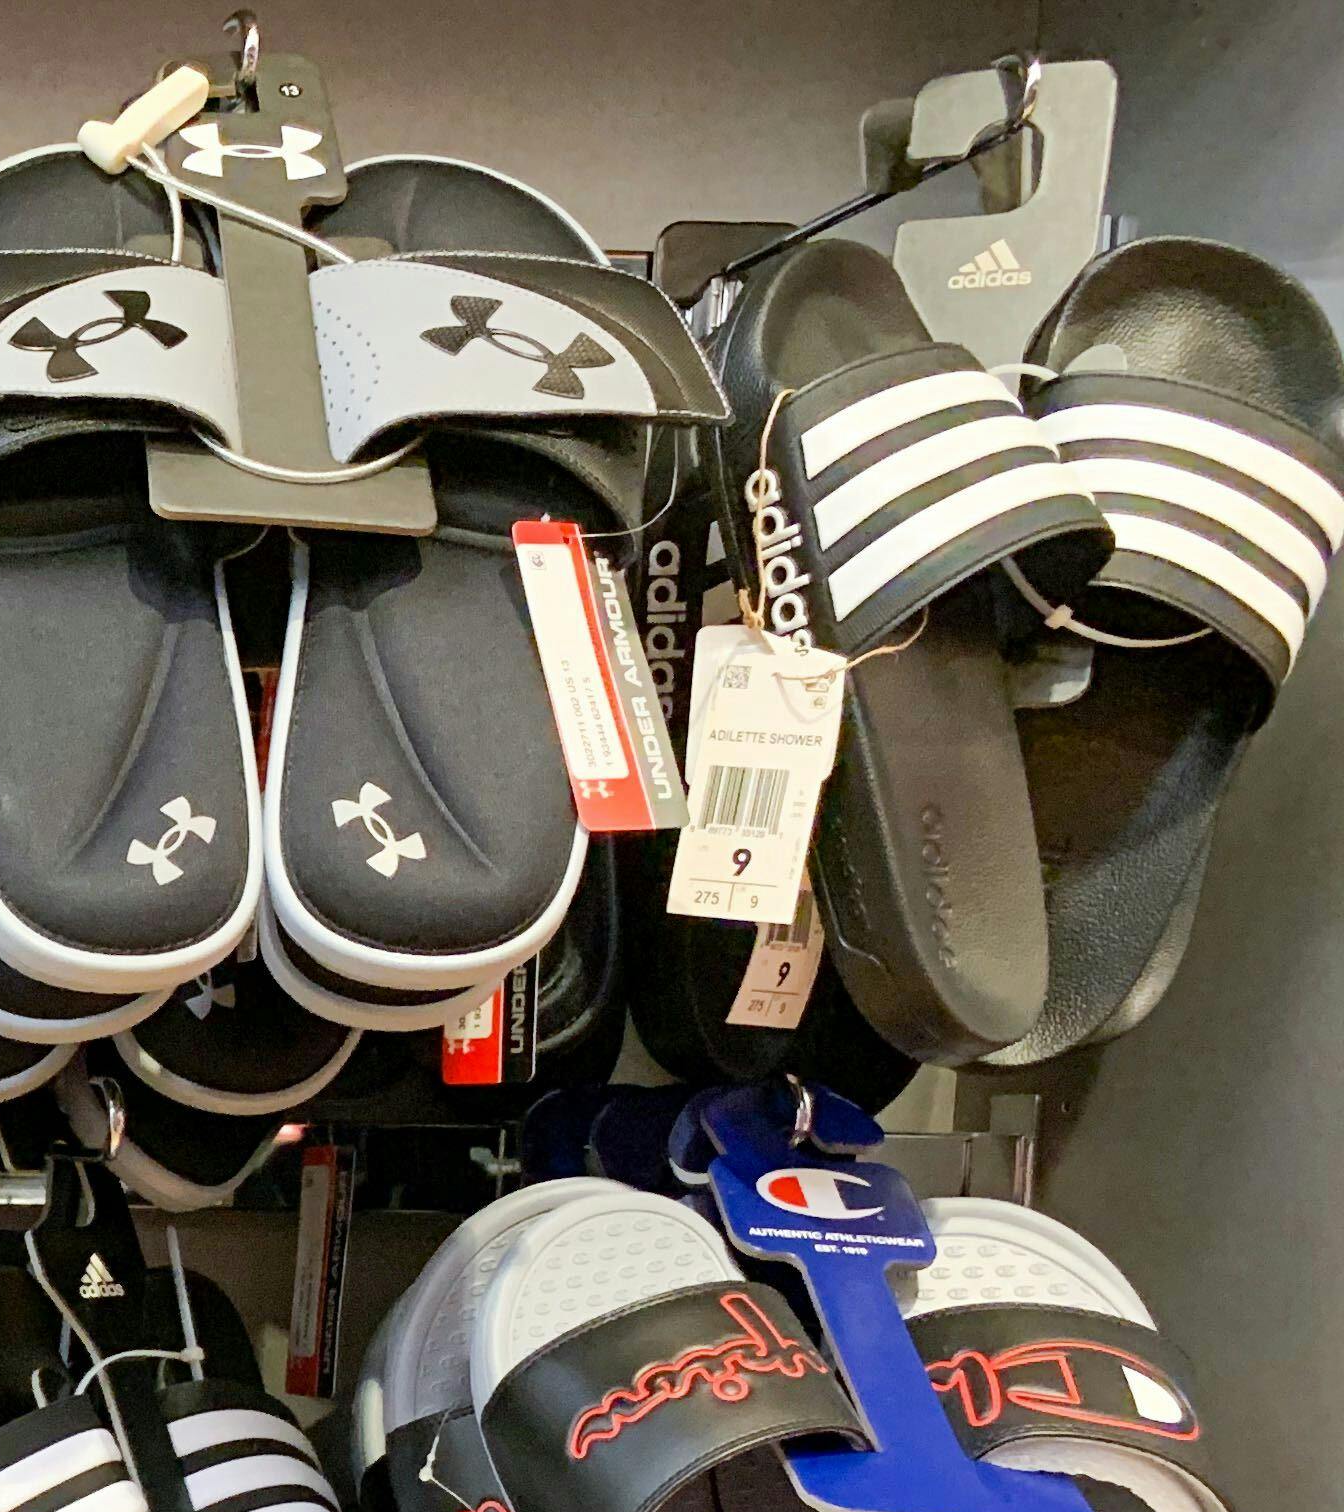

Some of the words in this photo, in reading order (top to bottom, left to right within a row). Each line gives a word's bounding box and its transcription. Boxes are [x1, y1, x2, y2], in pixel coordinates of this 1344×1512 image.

[281, 85, 300, 97] 13
[947, 268, 1032, 290] adidas
[744, 467, 813, 657] adidas
[594, 553, 644, 689] ARMOUR
[630, 696, 674, 801] UNDER
[708, 728, 766, 745] ADILETTE
[769, 731, 823, 748] SHOWER
[732, 847, 753, 877] 9
[693, 889, 720, 906] 275
[750, 895, 759, 909] 9
[776, 961, 792, 988] 9
[749, 1226, 823, 1241] AUTHENTIC
[824, 1231, 925, 1248] ATHLETICWEAR
[814, 1243, 841, 1254] EST.
[79, 1283, 125, 1299] adidas
